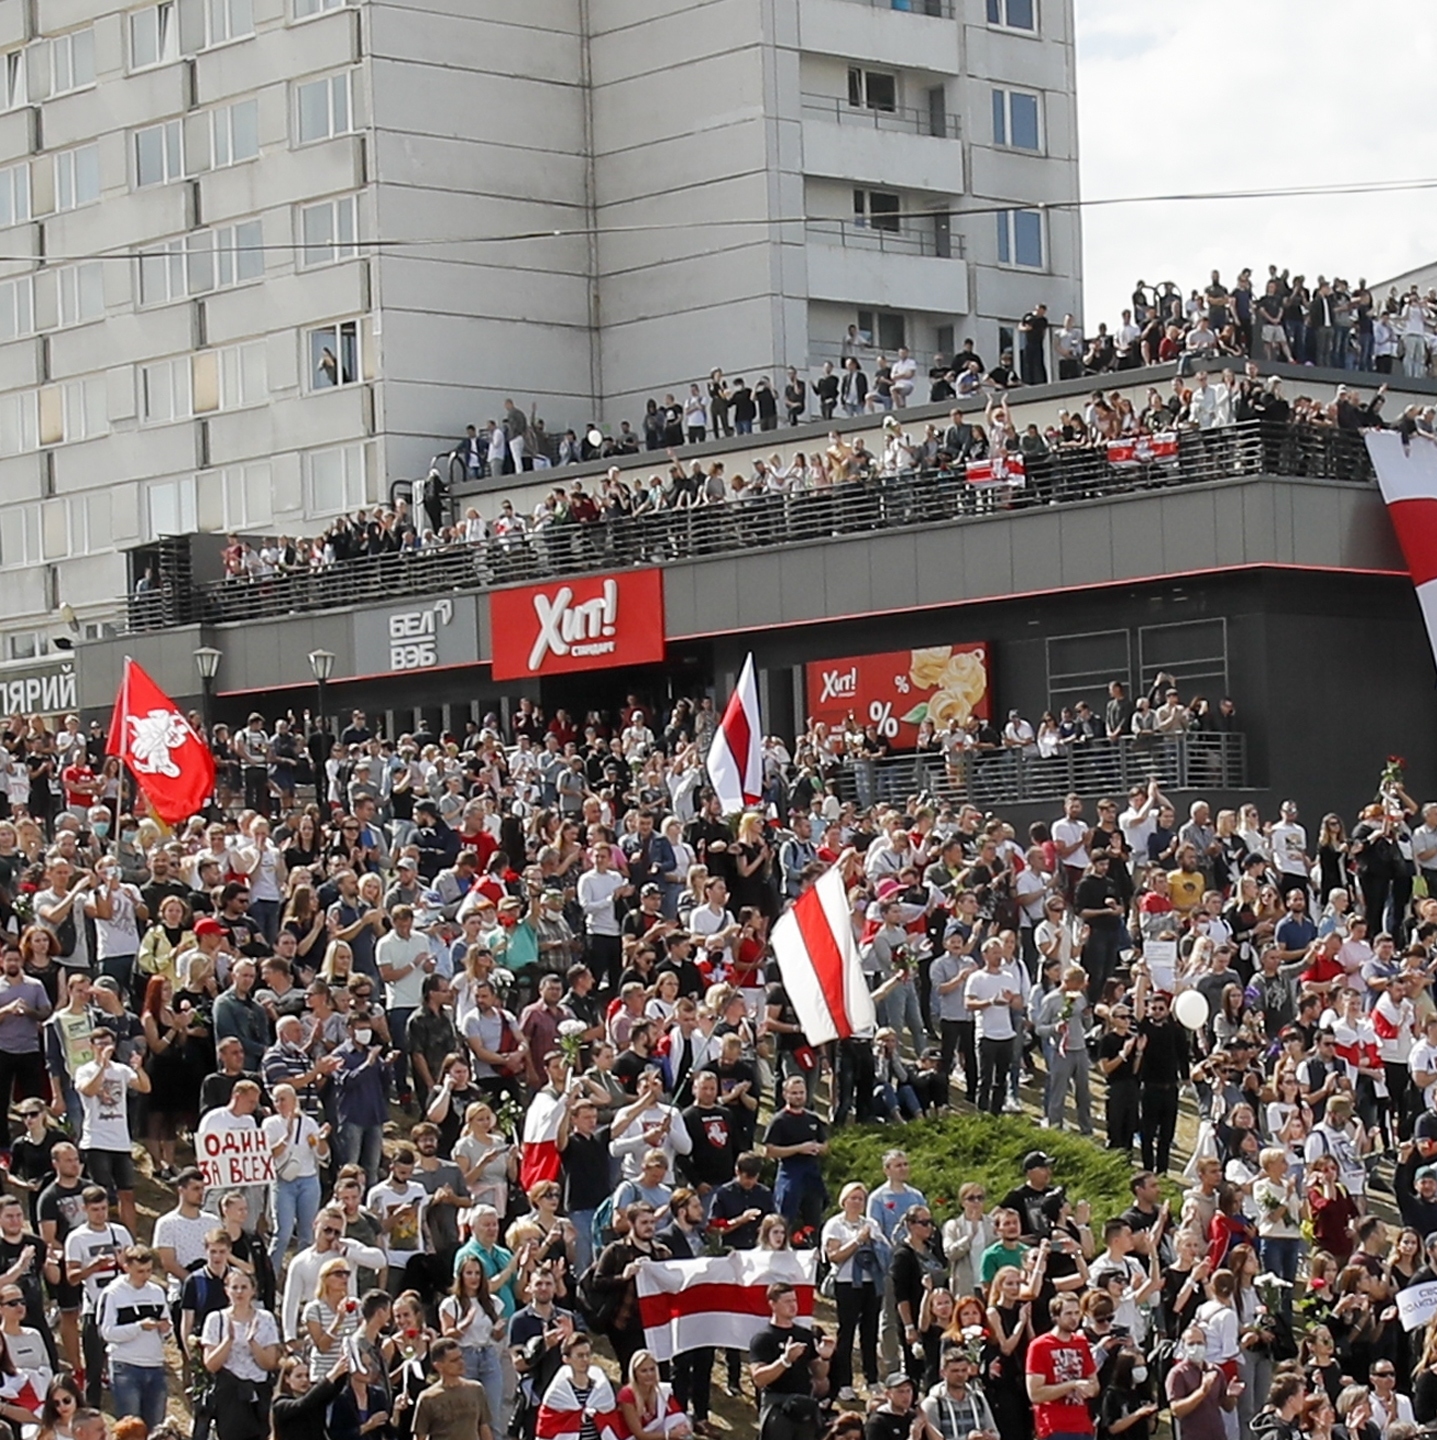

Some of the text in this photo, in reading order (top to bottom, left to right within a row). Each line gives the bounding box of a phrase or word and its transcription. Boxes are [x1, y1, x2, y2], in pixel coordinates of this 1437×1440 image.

[390, 610, 436, 638] БЕЛ
[530, 579, 617, 671] Хит!
[390, 643, 437, 671] ВЭБ
[205, 1131, 268, 1157] ОДИН
[199, 1155, 275, 1187] ЗА ВСЕХ
